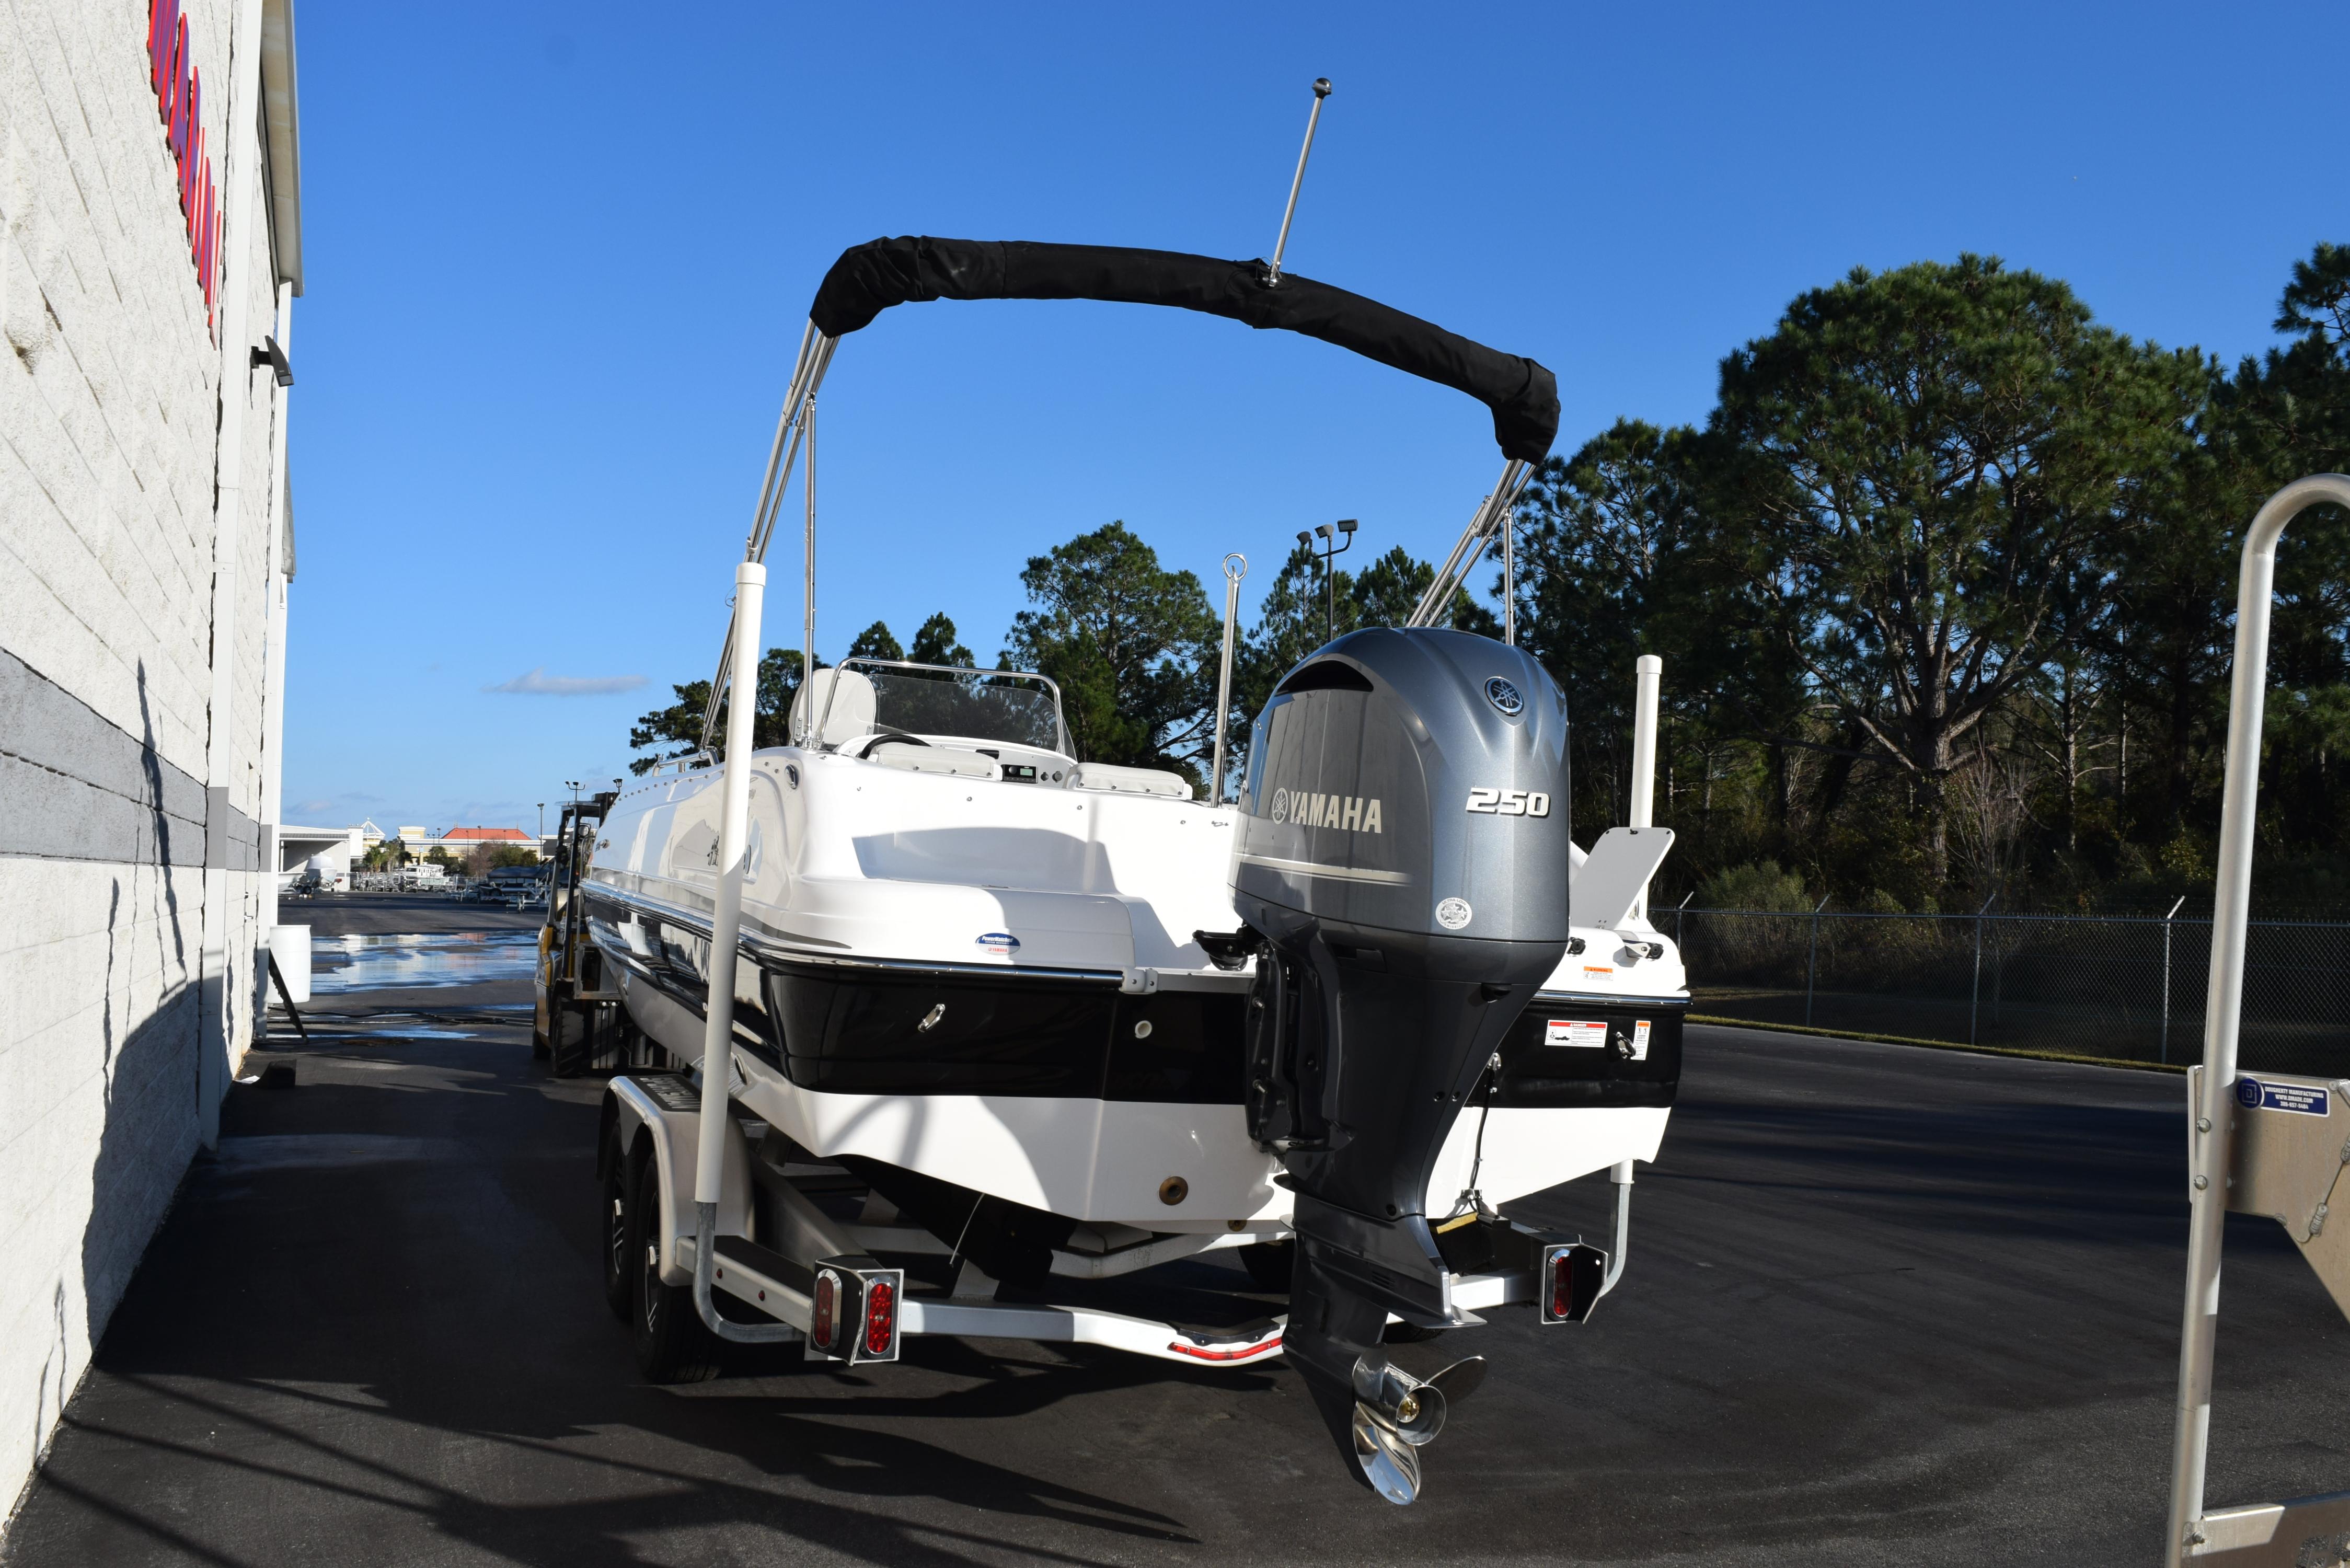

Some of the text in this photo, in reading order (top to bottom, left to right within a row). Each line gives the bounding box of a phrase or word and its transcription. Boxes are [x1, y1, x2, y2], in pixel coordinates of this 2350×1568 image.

[1289, 791, 1382, 834] YAMAHA
[1466, 787, 1550, 816] 250
[2289, 1089, 2324, 1098] MANUFACTURING
